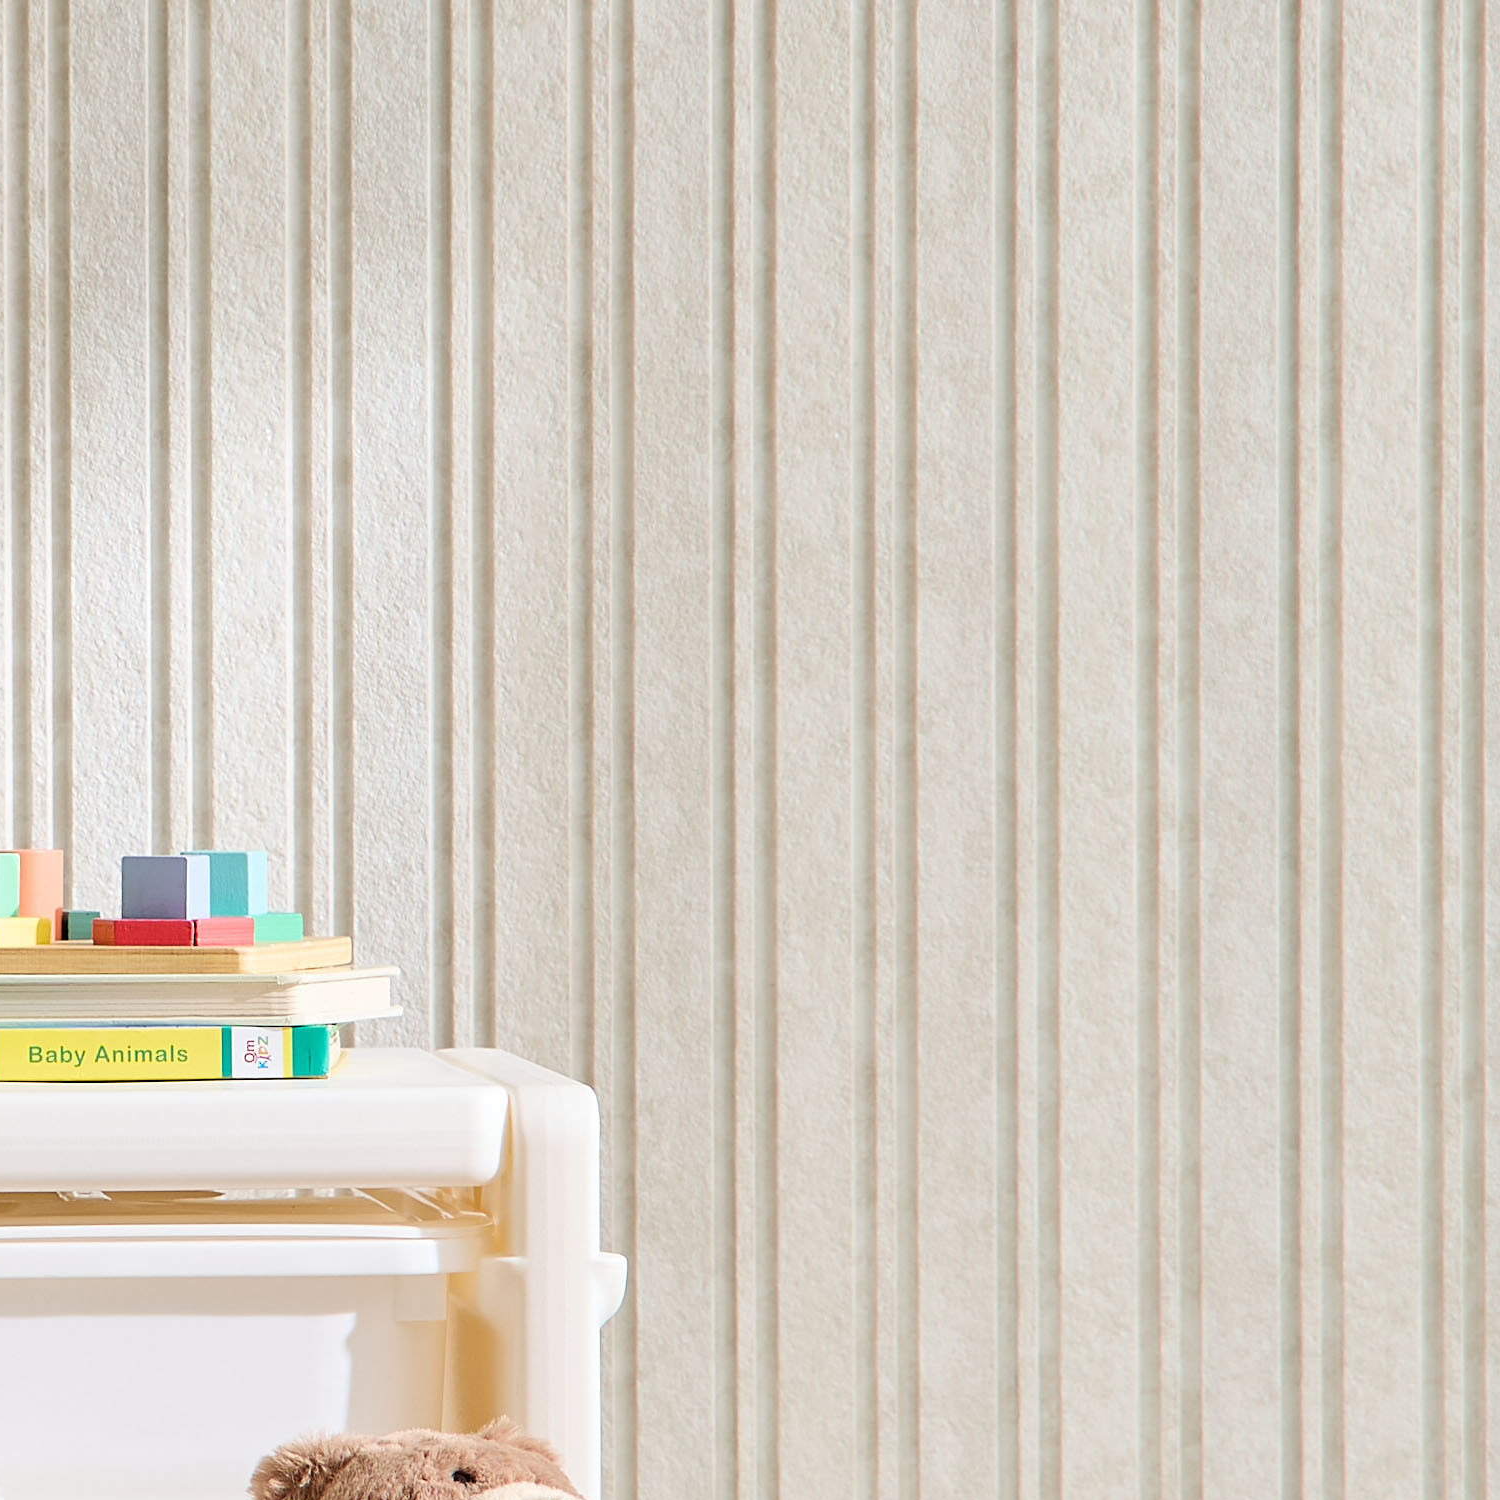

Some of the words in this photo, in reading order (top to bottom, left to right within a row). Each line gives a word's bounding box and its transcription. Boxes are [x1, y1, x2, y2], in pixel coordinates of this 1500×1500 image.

[28, 1045, 86, 1068] Baby
[94, 1045, 189, 1063] Animals
[244, 1040, 255, 1063] Om
